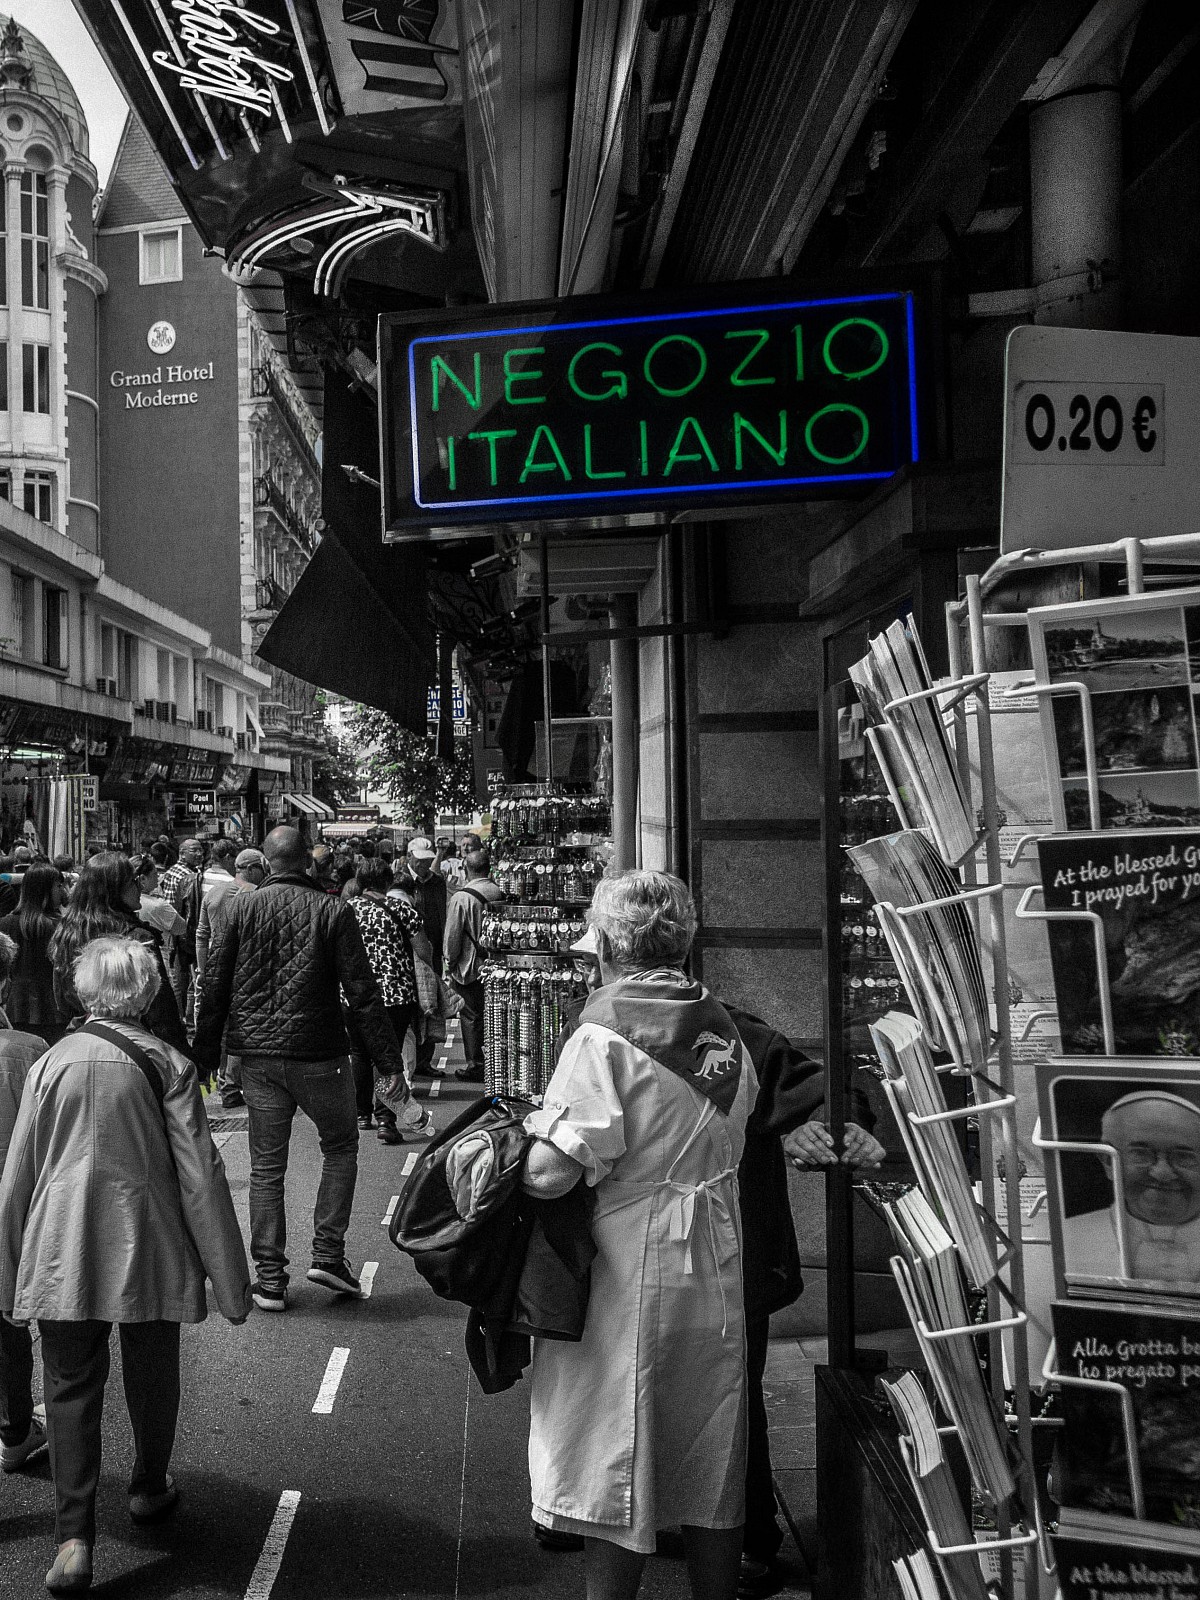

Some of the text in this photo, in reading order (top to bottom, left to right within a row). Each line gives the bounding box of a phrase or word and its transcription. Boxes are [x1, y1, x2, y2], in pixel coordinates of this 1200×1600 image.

[110, 361, 214, 388] Grand Hotel
[431, 316, 890, 412] NEGOZIO
[125, 388, 198, 409] Moderne
[1025, 393, 1157, 453] 0.20 €
[448, 402, 870, 491] ITALIANO
[193, 793, 209, 802] Paul
[1053, 868, 1076, 888] At
[1079, 859, 1112, 882] the
[1114, 844, 1181, 876] blessed
[1071, 889, 1082, 907] I
[1085, 874, 1150, 911] prayed
[1151, 871, 1178, 904] for
[1072, 1337, 1114, 1358] Alla
[1116, 1339, 1180, 1361] Grotta
[1078, 1359, 1100, 1379] ho
[1105, 1361, 1176, 1388] pregato
[1069, 1562, 1200, 1585] At the blessed
